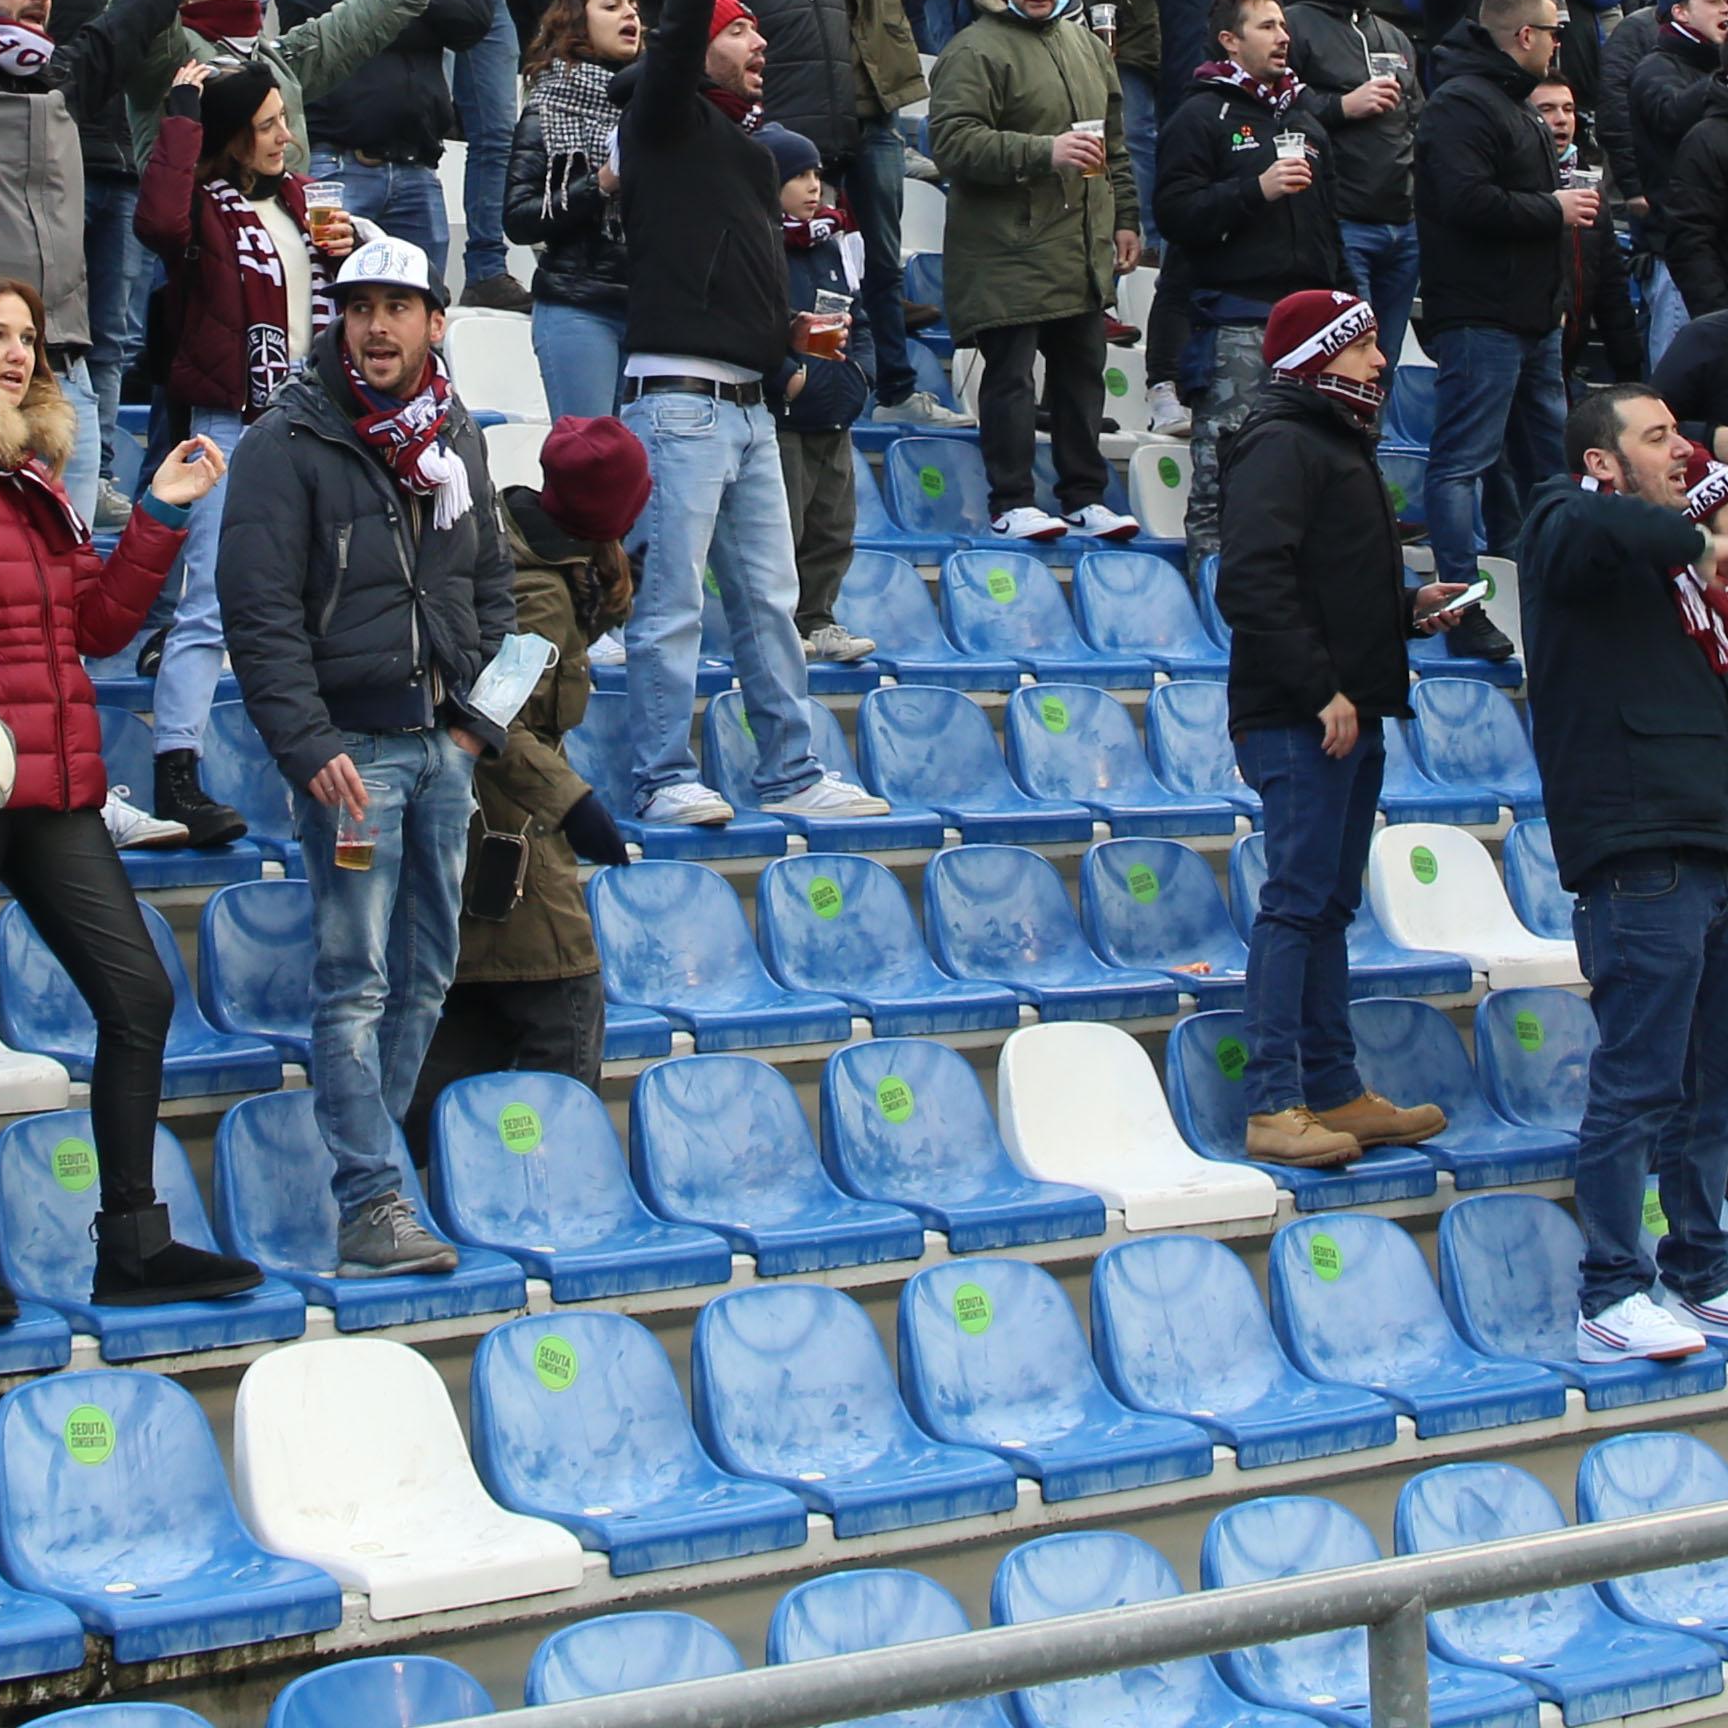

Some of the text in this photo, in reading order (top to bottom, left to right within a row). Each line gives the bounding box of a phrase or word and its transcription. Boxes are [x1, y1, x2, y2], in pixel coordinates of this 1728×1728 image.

[503, 1116, 533, 1130] SEDUTA
[57, 1152, 89, 1167] SEDUTA
[1312, 1245, 1337, 1259] SEDUTA
[957, 1296, 985, 1311] SEDUTA
[539, 1345, 571, 1368] SEDUTA
[537, 1358, 569, 1380] CONSENTITA
[70, 1422, 107, 1436] SEDUTA
[71, 1435, 107, 1448] CONSENTITA
